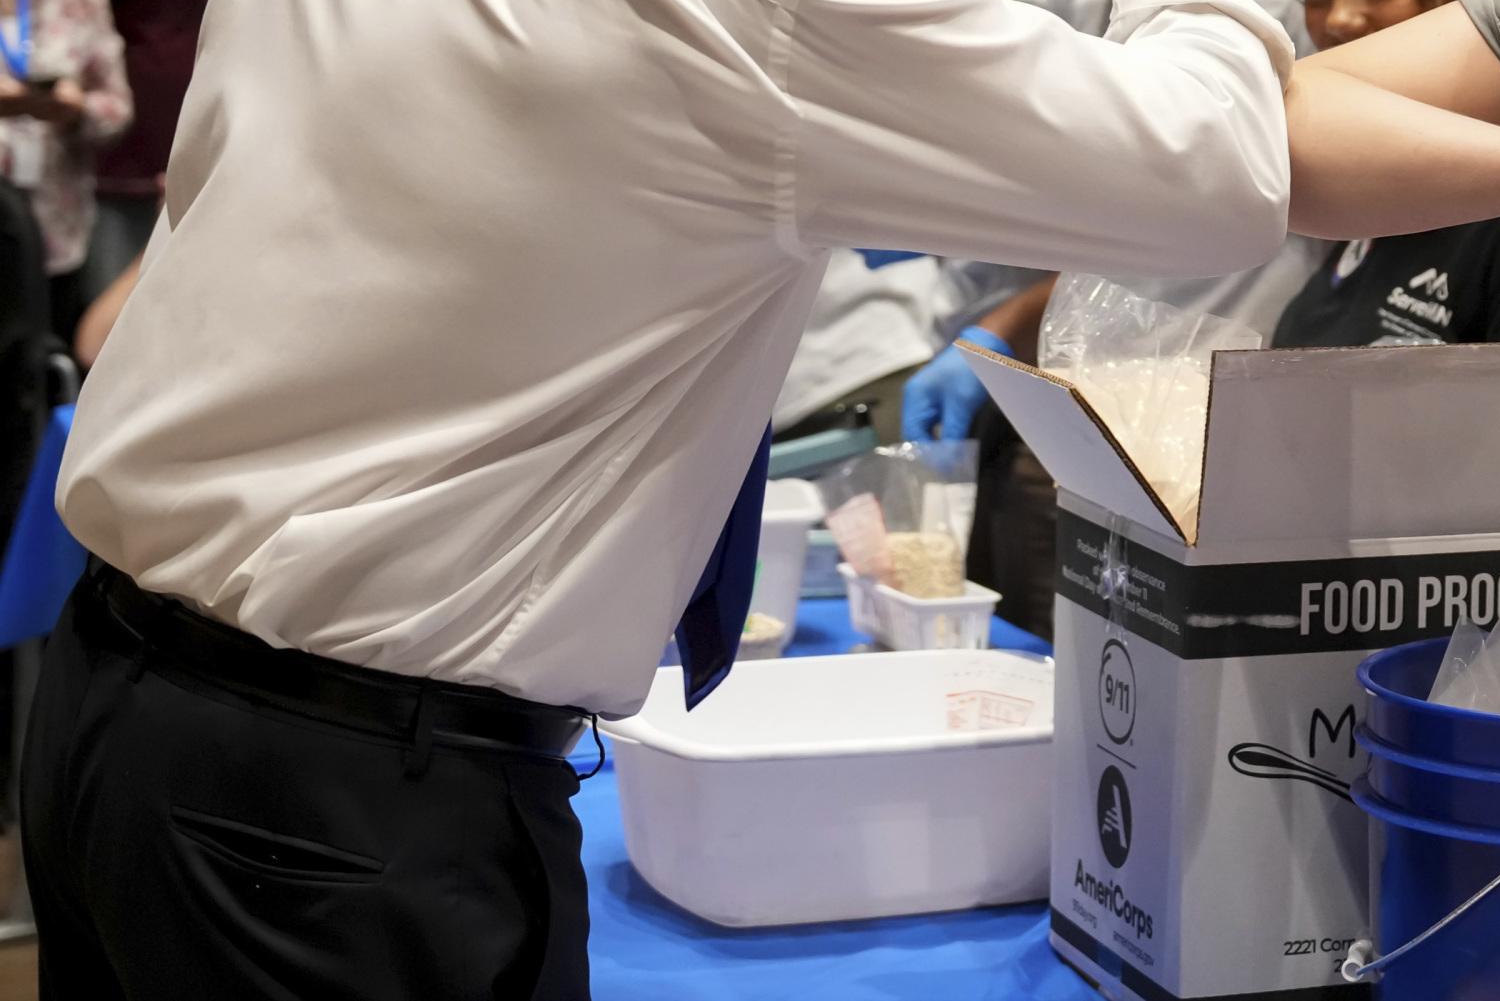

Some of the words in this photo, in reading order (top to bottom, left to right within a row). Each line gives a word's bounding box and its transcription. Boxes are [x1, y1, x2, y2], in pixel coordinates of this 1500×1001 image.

[1300, 578, 1404, 635] FOOD
[1105, 673, 1130, 714] 9/11
[1074, 858, 1154, 940] AmeriCorps
[1283, 939, 1317, 956] 2221
